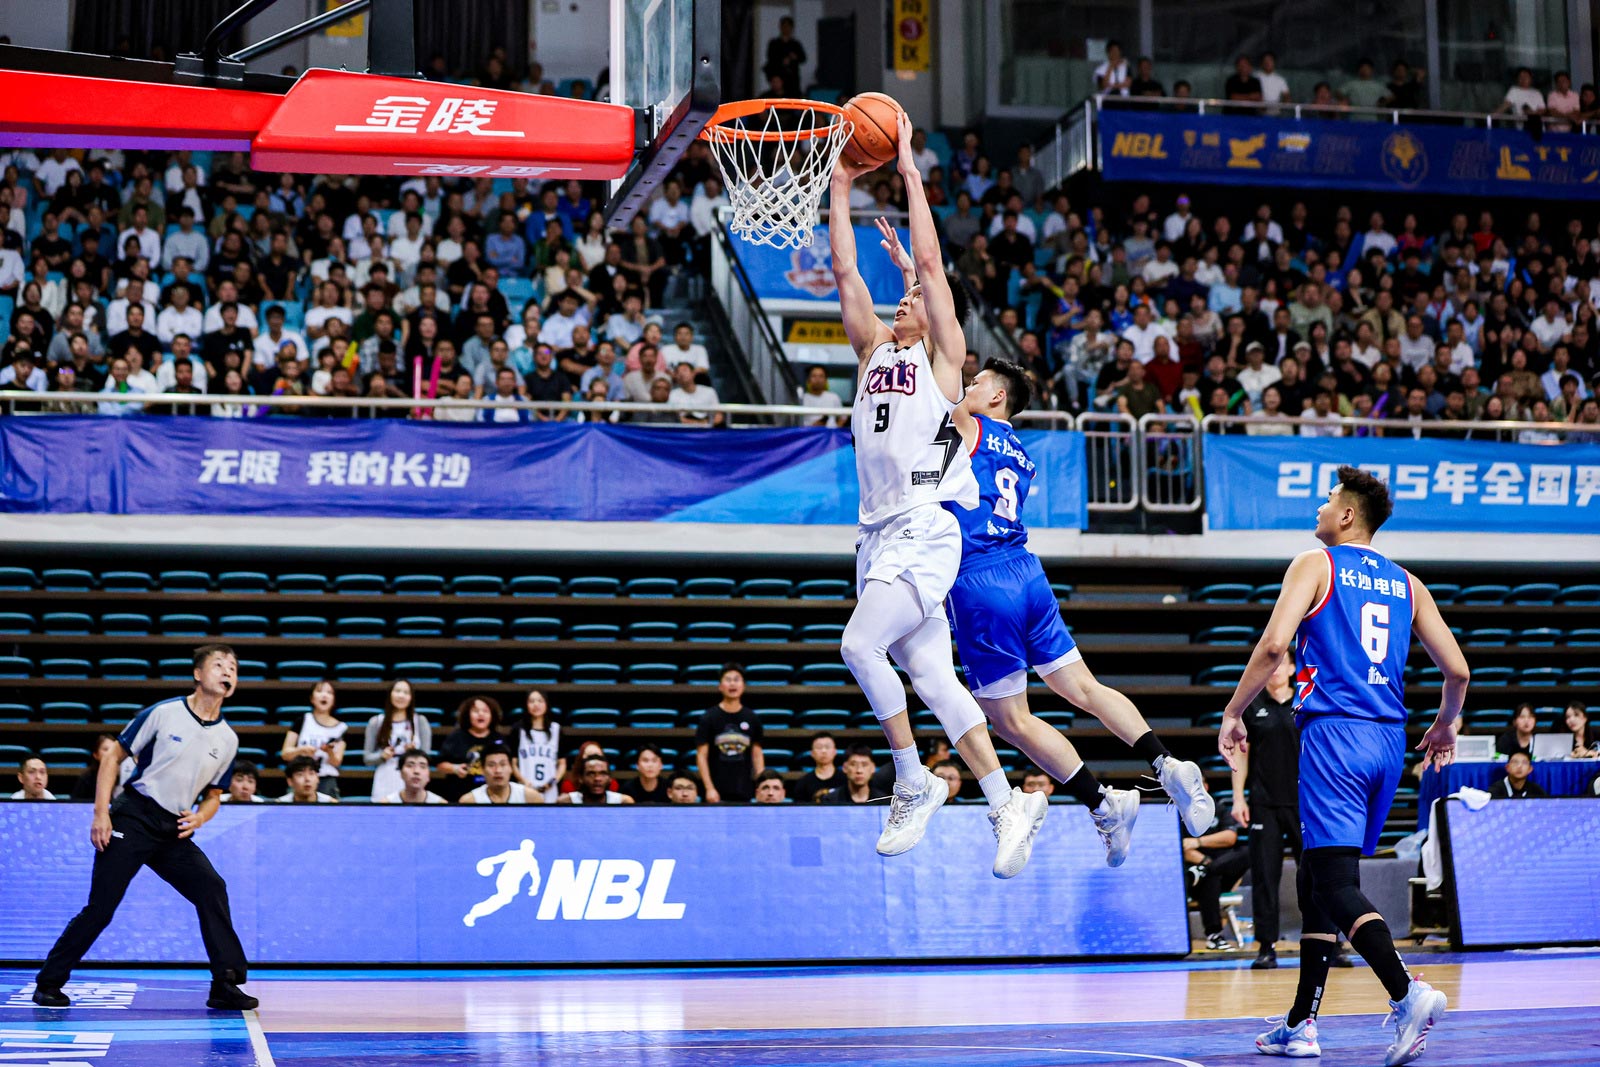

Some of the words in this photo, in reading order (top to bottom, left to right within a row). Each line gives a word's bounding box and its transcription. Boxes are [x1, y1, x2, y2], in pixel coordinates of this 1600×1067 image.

[335, 96, 525, 137] 金陵
[1111, 131, 1168, 159] NBL
[874, 402, 890, 432] 9
[199, 449, 281, 484] 无限
[306, 451, 471, 488] 我的长沙
[993, 467, 1019, 522] 9
[1339, 567, 1407, 600] 长沙电信
[1360, 601, 1390, 665] 6
[534, 763, 545, 781] 6
[535, 858, 687, 921] NBL
